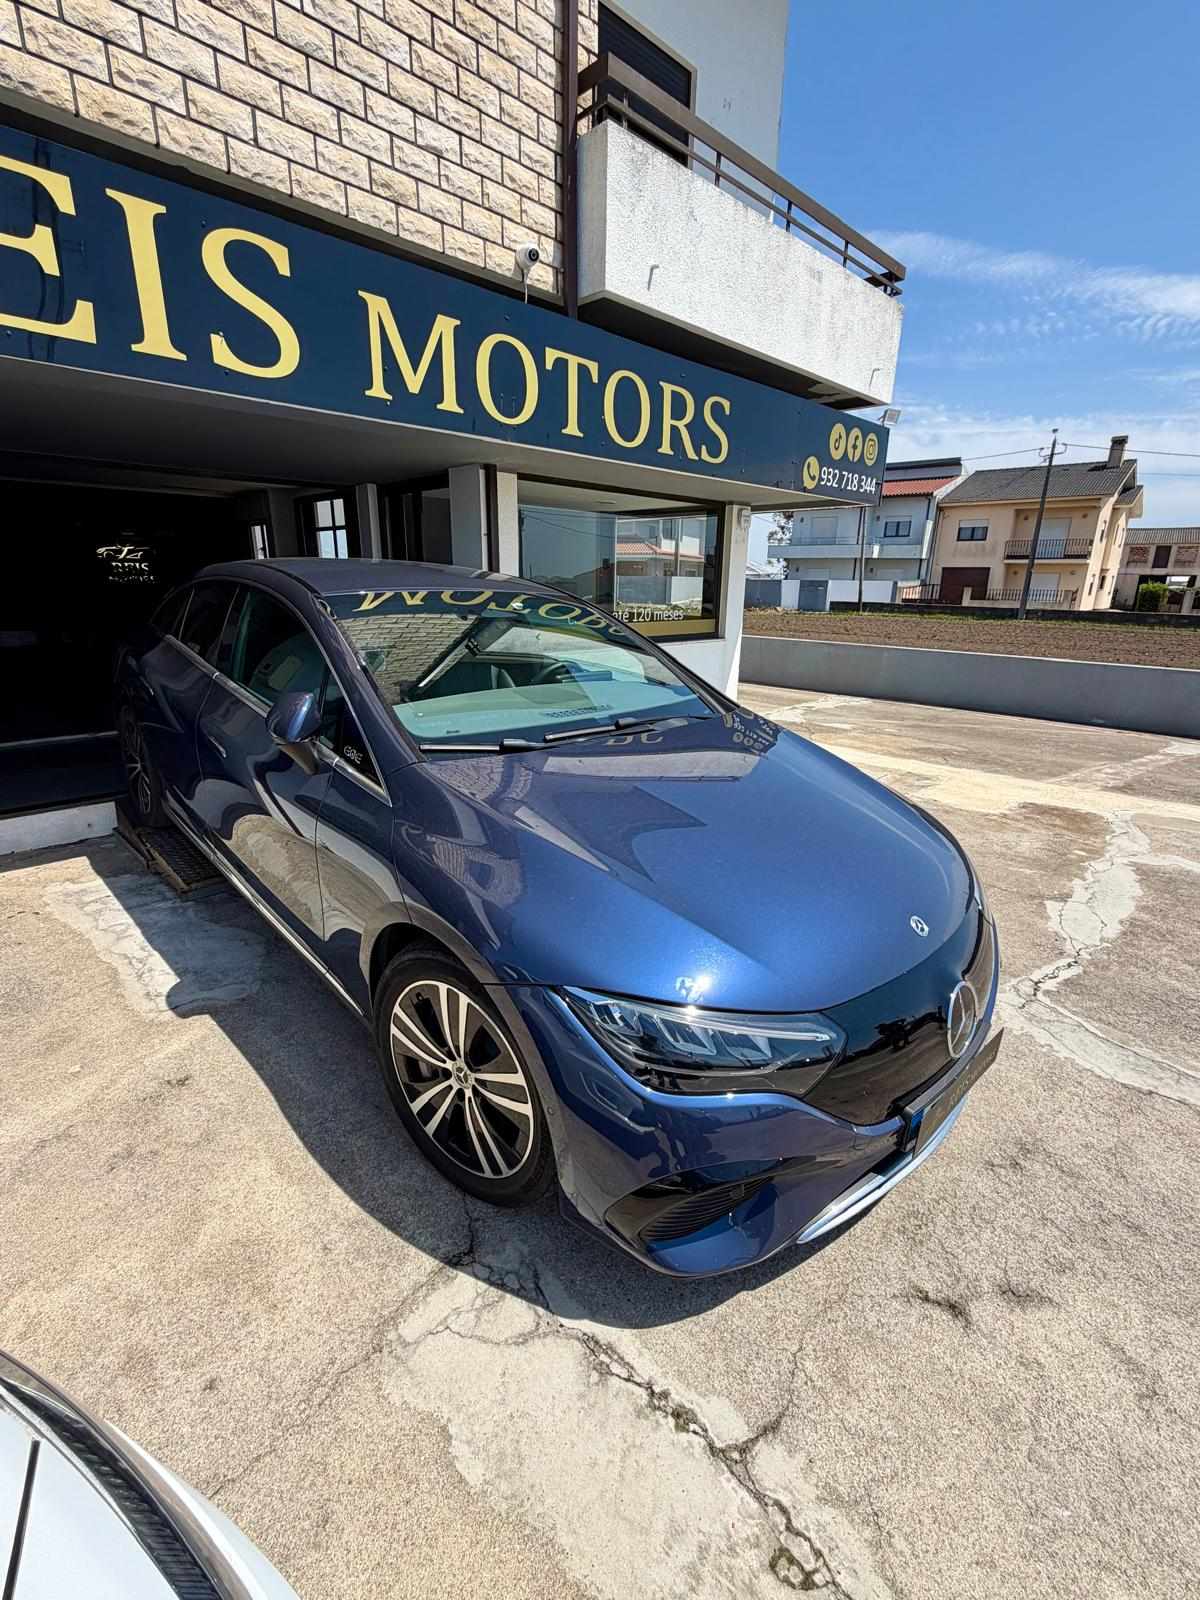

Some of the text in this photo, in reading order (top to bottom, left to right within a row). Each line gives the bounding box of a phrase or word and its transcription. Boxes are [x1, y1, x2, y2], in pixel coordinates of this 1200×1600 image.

[358, 290, 731, 464] MOTORS
[820, 466, 877, 494] 932 718 344
[633, 608, 652, 622] 120
[653, 609, 684, 621] meses
